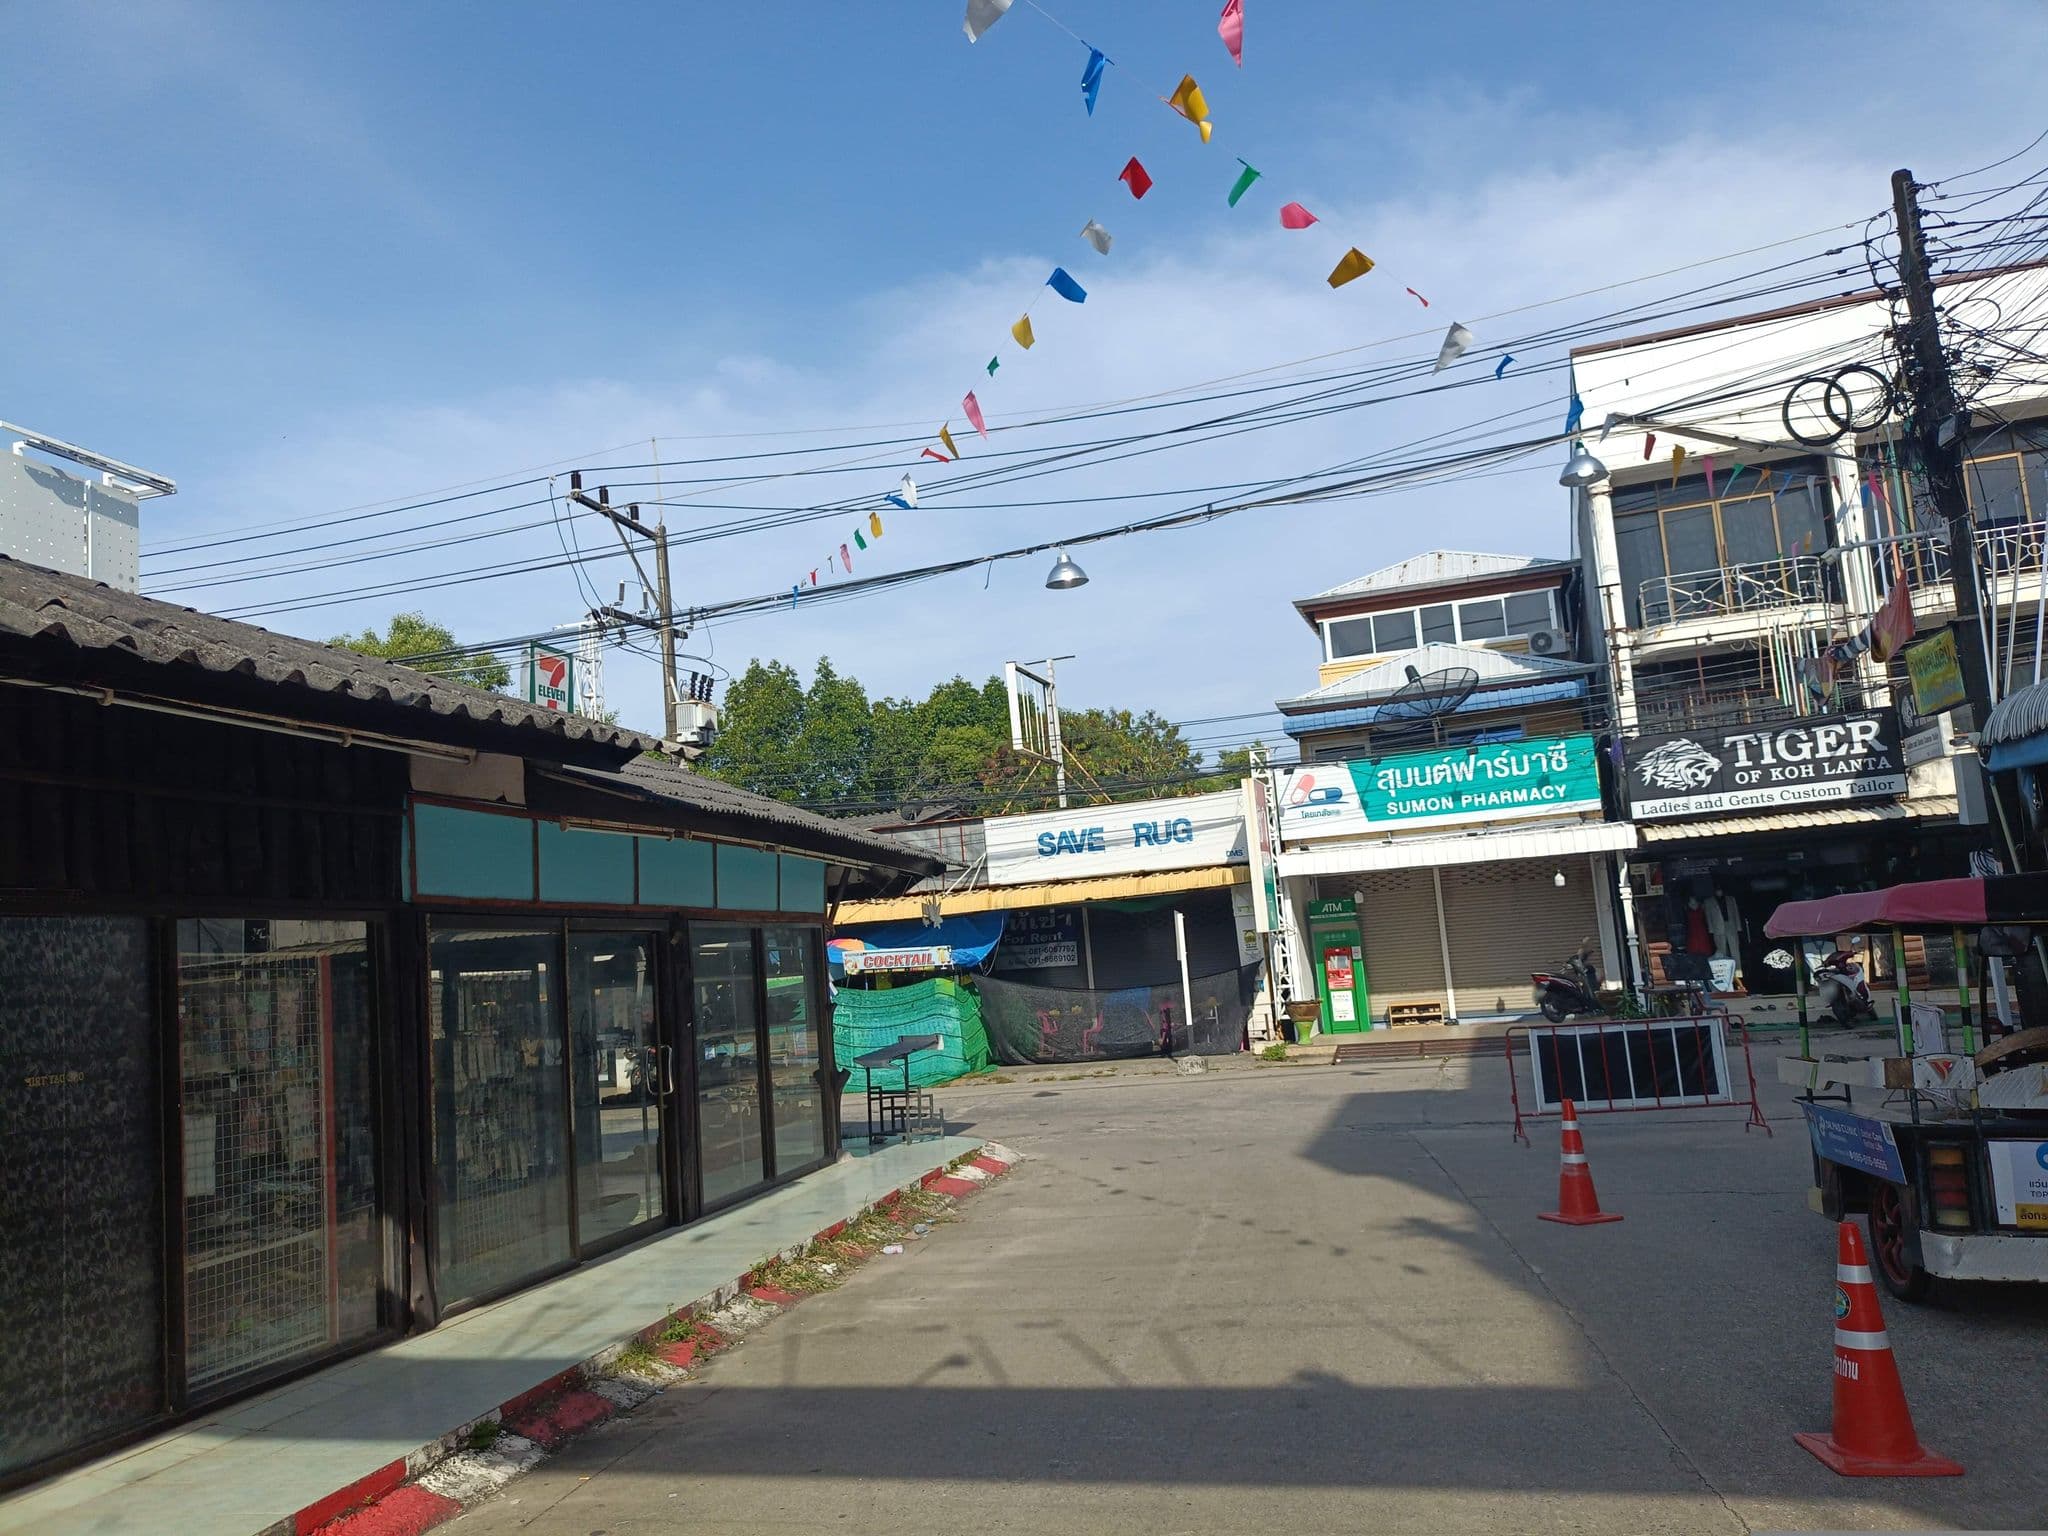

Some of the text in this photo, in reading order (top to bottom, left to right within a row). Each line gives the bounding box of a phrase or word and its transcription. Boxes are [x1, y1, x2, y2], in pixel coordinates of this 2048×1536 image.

[1723, 720, 1888, 768] TIGER
[1734, 757, 1892, 785] OF KOH LANTA
[1386, 784, 1567, 815] SUMON PHARMACY
[1640, 779, 1895, 816] Ladies and Gents Custom Tailor
[1037, 818, 1194, 857] SAVE RUG
[1321, 902, 1343, 913] ATM
[1031, 931, 1063, 943] Rent
[863, 952, 935, 969] COCKTAIL
